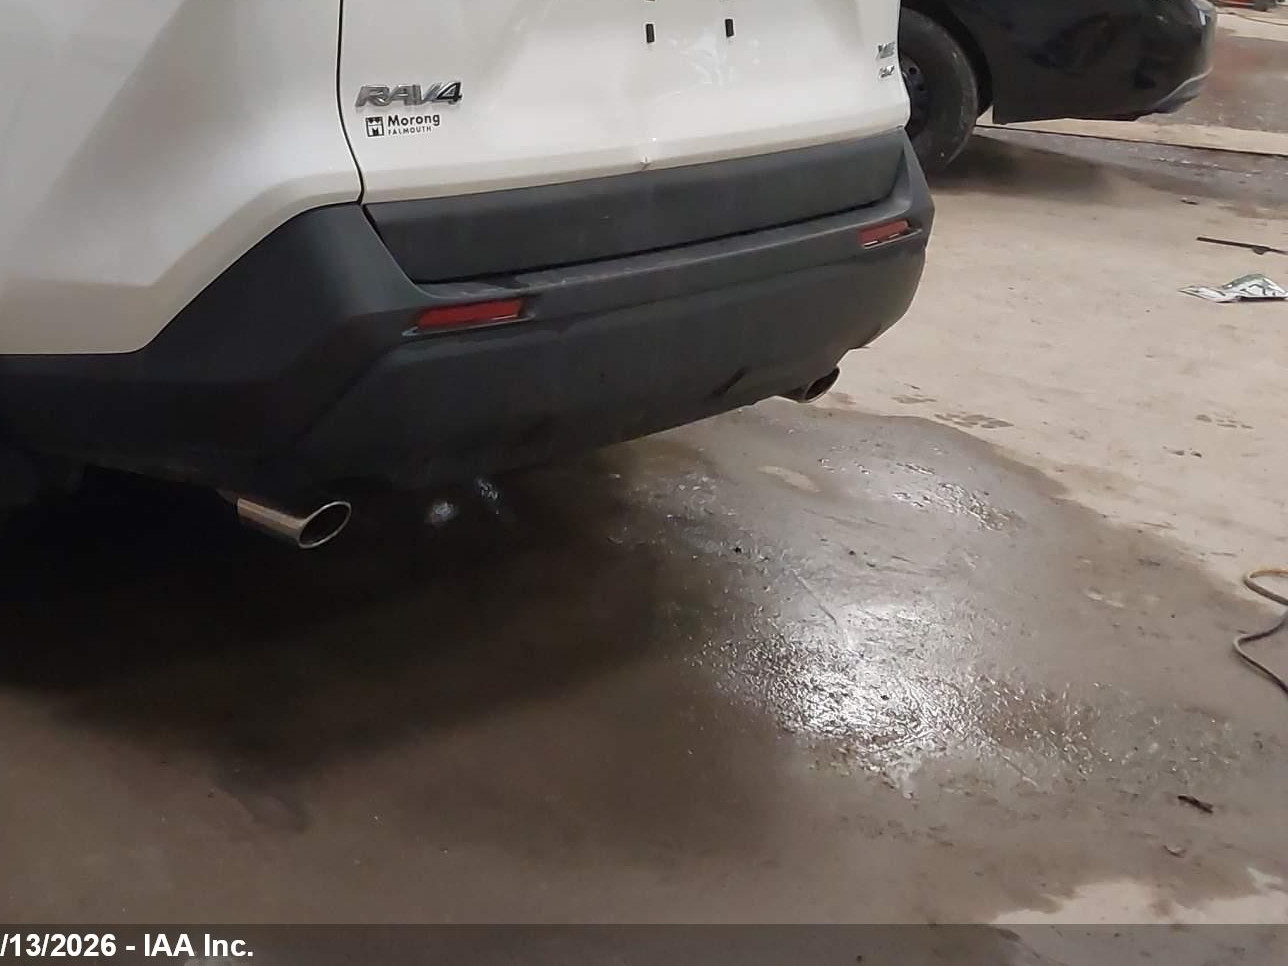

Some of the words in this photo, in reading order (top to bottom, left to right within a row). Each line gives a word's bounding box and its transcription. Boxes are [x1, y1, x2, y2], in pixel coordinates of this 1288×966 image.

[355, 82, 462, 108] RAV4
[388, 114, 440, 127] Morong
[388, 126, 432, 136] FALMOUTH
